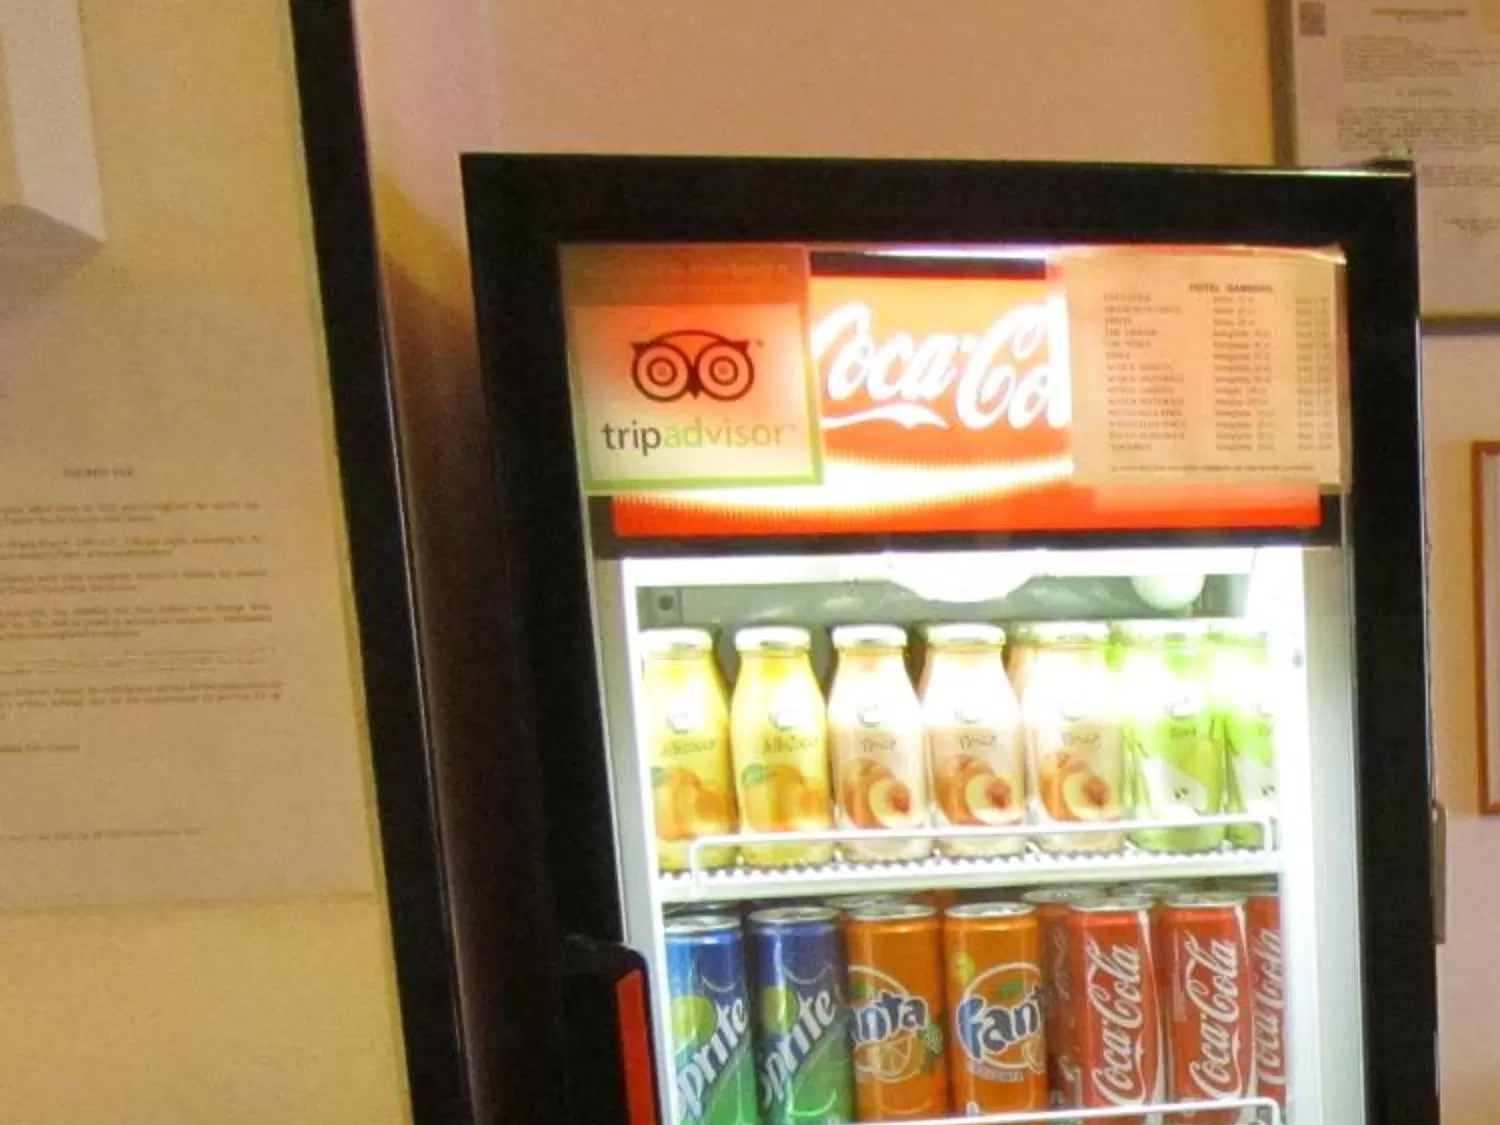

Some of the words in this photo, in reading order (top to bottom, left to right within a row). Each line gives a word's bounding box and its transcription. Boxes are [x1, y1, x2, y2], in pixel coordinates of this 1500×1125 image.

[600, 417, 784, 457] tripadvisor
[849, 989, 929, 1045] nta
[956, 984, 1042, 1062] Fan
[675, 997, 749, 1122] prite
